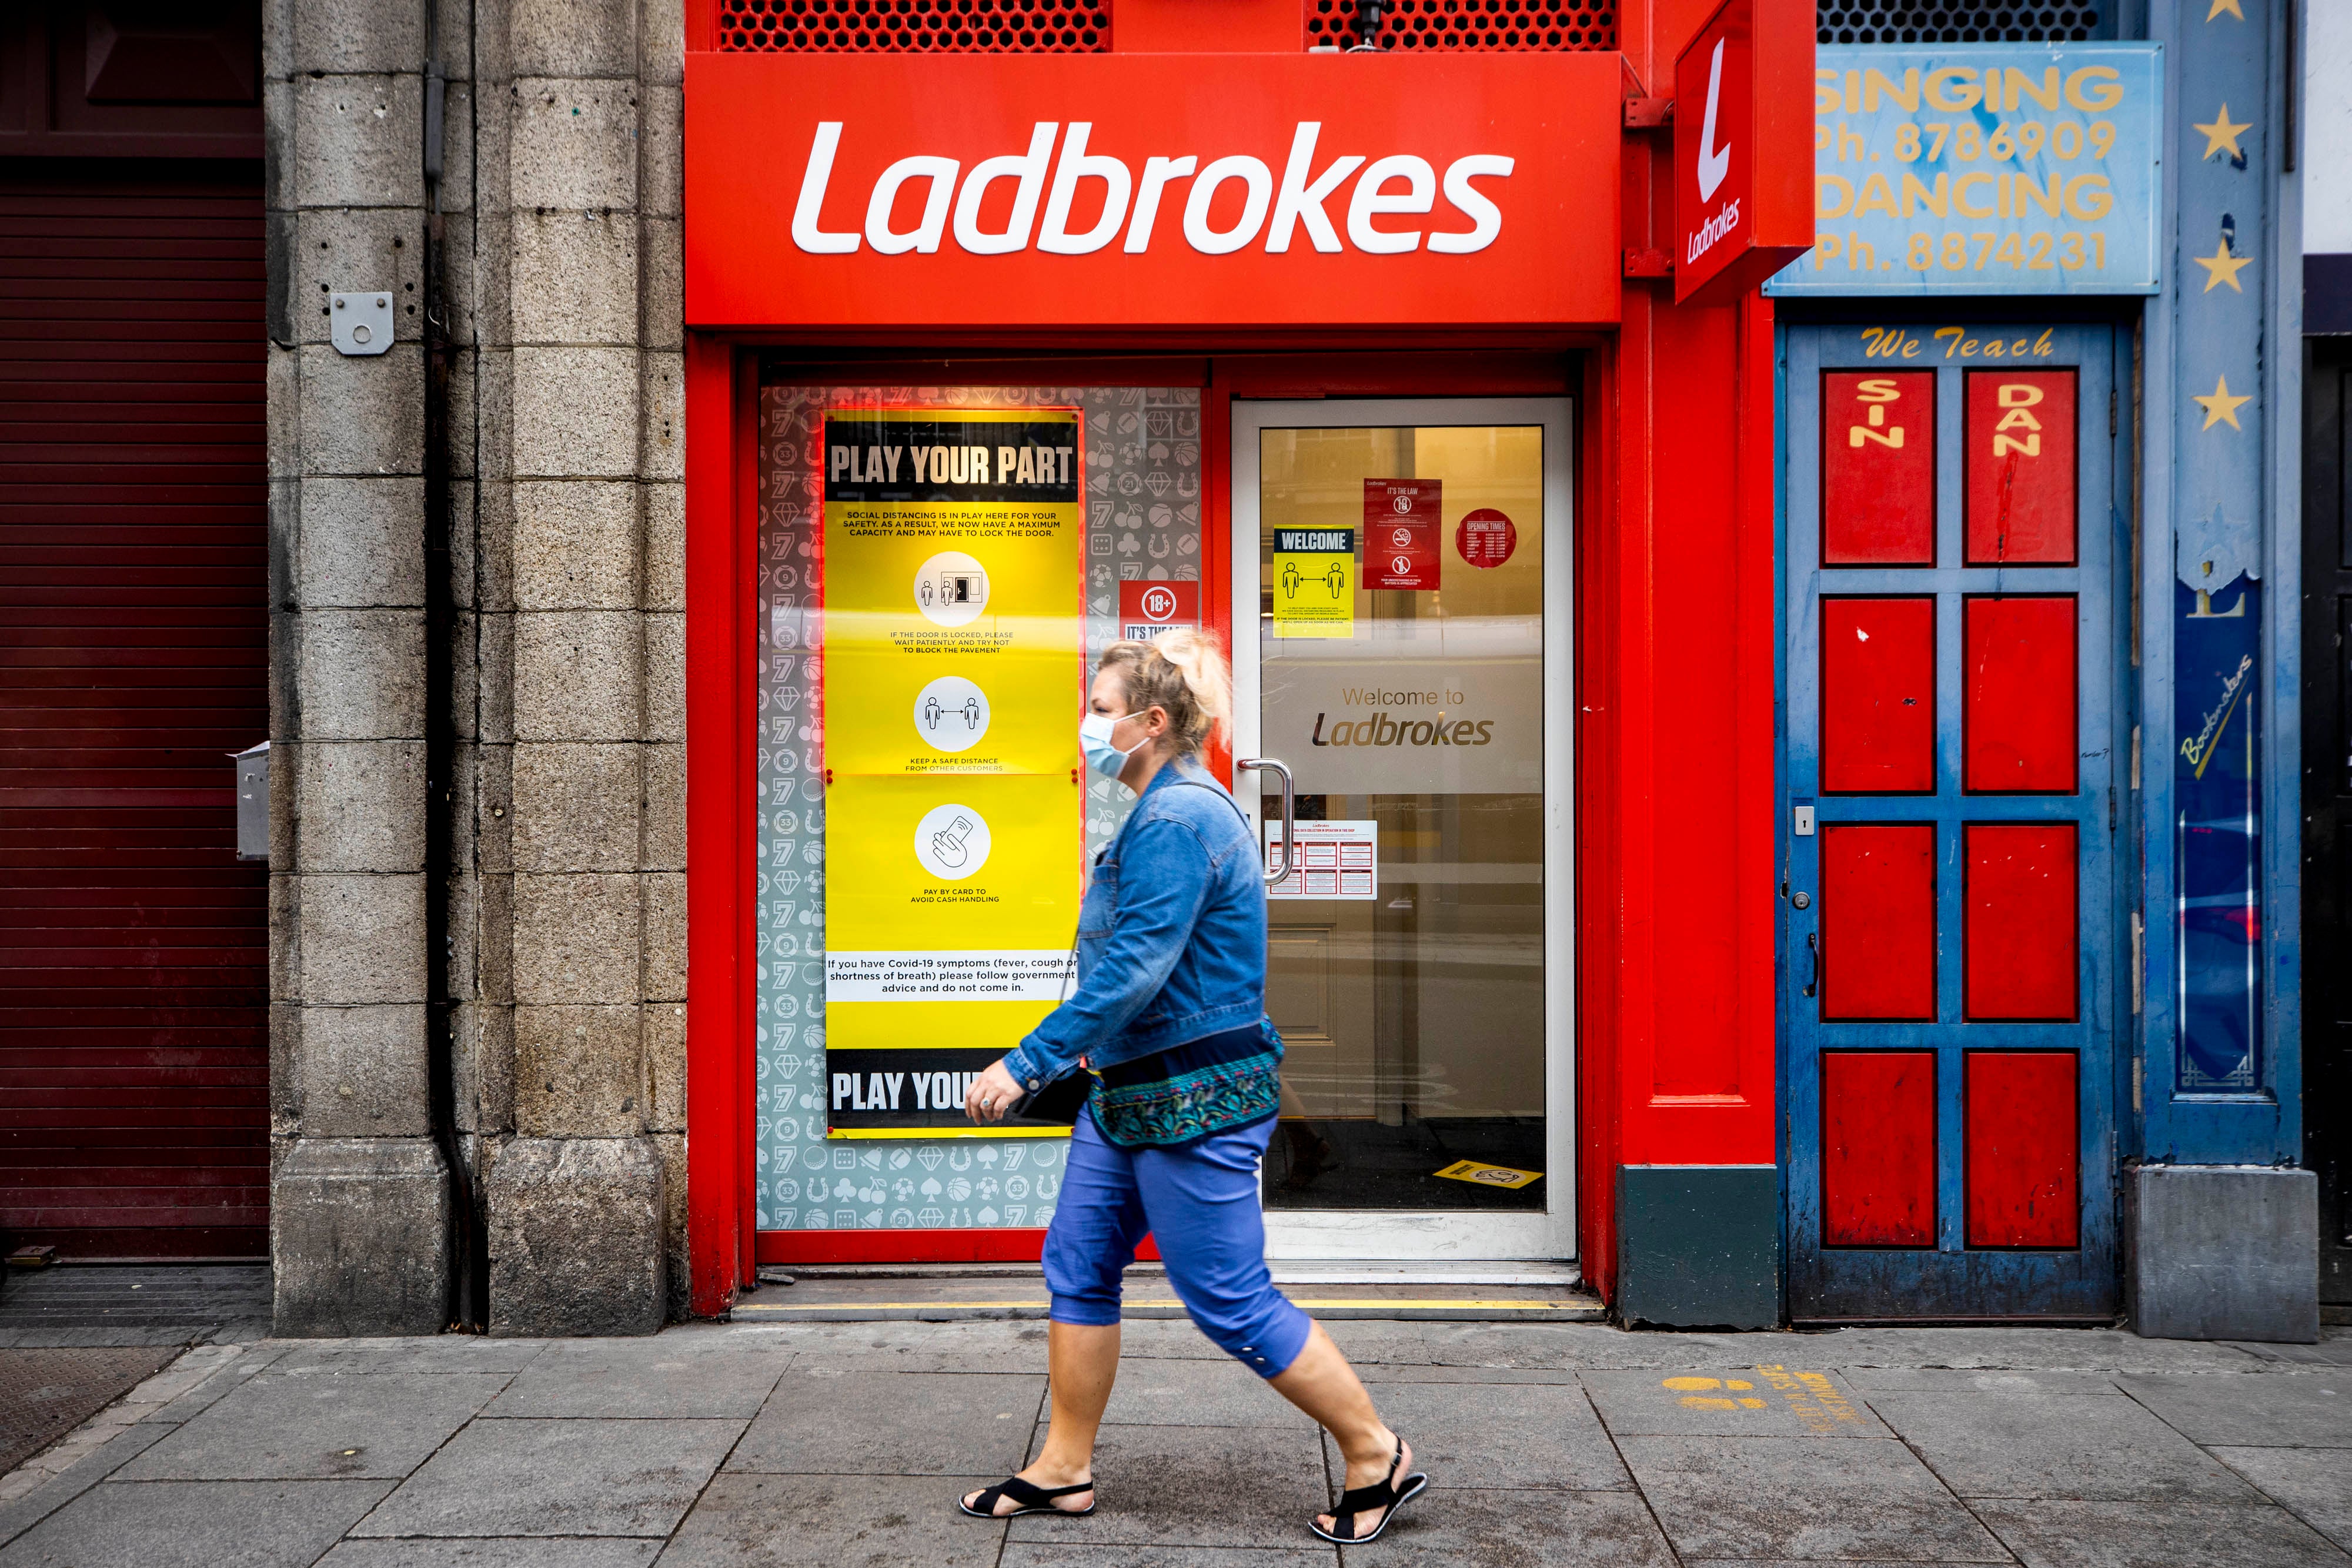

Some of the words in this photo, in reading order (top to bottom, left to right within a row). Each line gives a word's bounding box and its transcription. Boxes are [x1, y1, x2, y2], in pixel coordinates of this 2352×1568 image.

[1815, 67, 2123, 113] SINGING
[1895, 121, 2116, 161] 8786909
[791, 121, 1515, 255] Ladbrokes
[1815, 172, 2113, 220] DANCING
[1688, 198, 1740, 265] Ladbrokes
[1815, 231, 1891, 271] Ph.
[1907, 232, 2105, 271] 8874231
[1860, 327, 1920, 358] We
[1934, 326, 2054, 358] Teach
[831, 446, 902, 482] PLAY
[910, 446, 988, 483] YOUR
[998, 447, 1072, 483] PART
[1282, 532, 1345, 550] WELCOME
[1149, 595, 1171, 612] 18+
[1127, 627, 1145, 639] IT'S
[1342, 688, 1438, 705] Welcome
[1445, 688, 1464, 705] to
[1312, 712, 1494, 746] Ladbrokes
[898, 972, 936, 981] breath)
[940, 972, 973, 981] please
[1013, 971, 1075, 980] government
[937, 959, 990, 968] symptoms
[994, 959, 1027, 968] (fever,
[1031, 958, 1063, 968] cough
[882, 984, 916, 992] advice
[920, 984, 938, 992] and
[942, 984, 956, 992] do
[960, 984, 976, 992] not
[980, 984, 1008, 992] come
[1011, 984, 1024, 992] in.
[833, 1073, 904, 1110] PLAY
[911, 1072, 983, 1109] YOU
